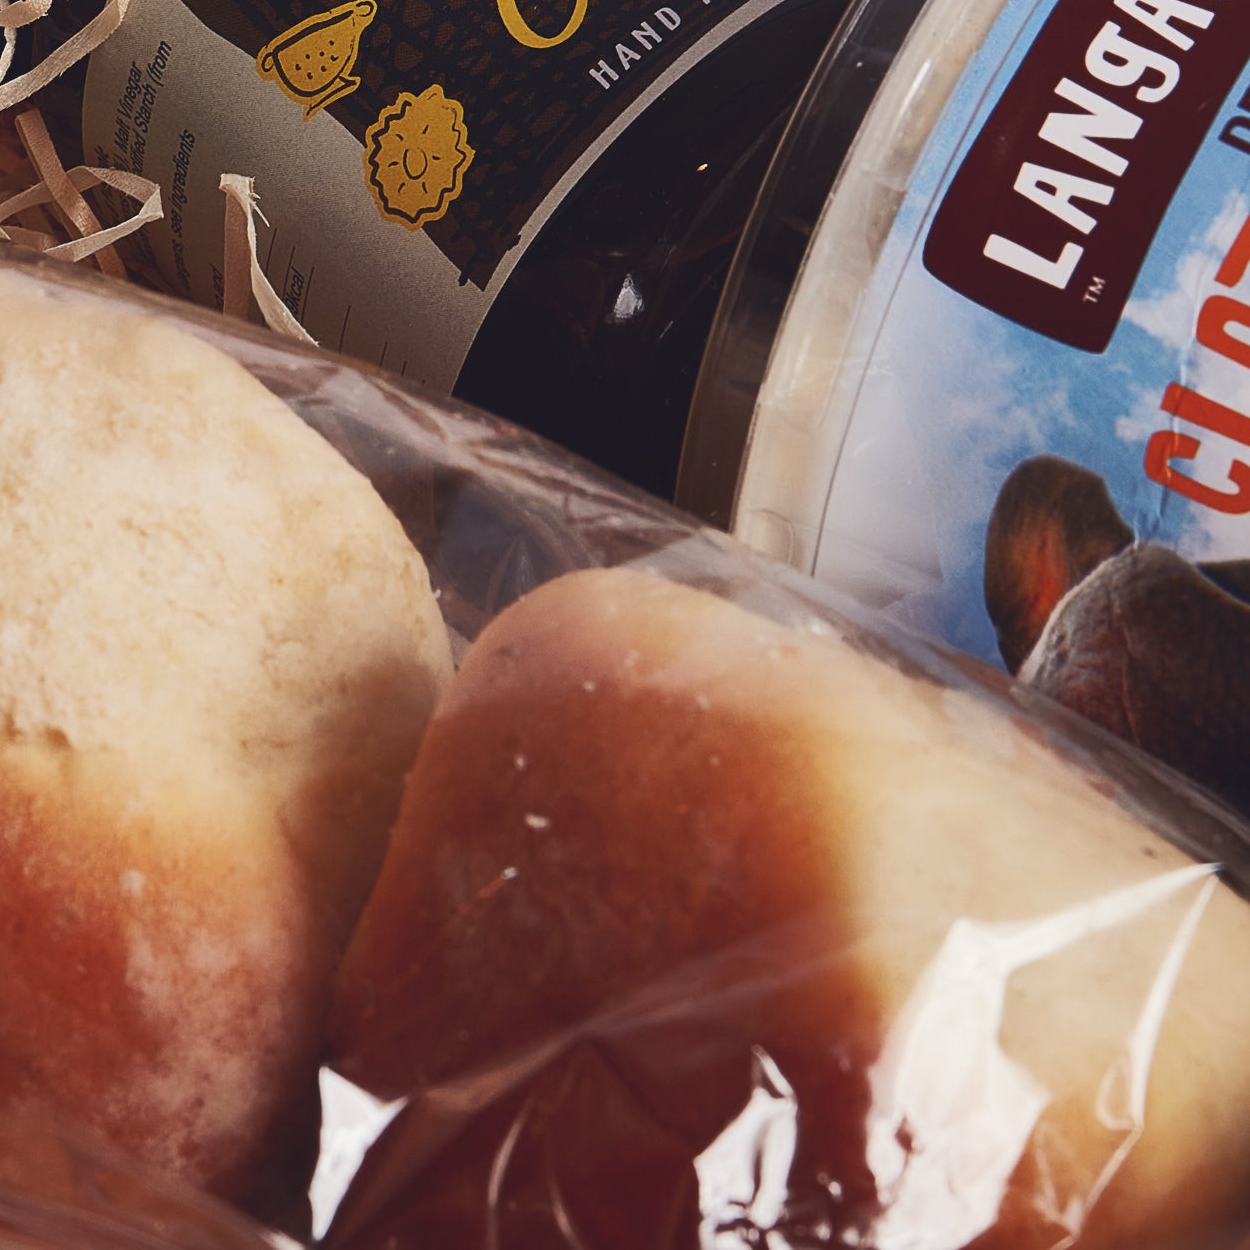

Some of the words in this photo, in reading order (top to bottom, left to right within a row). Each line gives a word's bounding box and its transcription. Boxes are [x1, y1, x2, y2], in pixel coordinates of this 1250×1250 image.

[117, 60, 143, 120] Vinegar
[133, 83, 157, 133] Starch
[145, 40, 173, 87] (from
[587, 10, 683, 90] HAND
[168, 129, 196, 213] ingredients
[1083, 276, 1107, 303] TM
